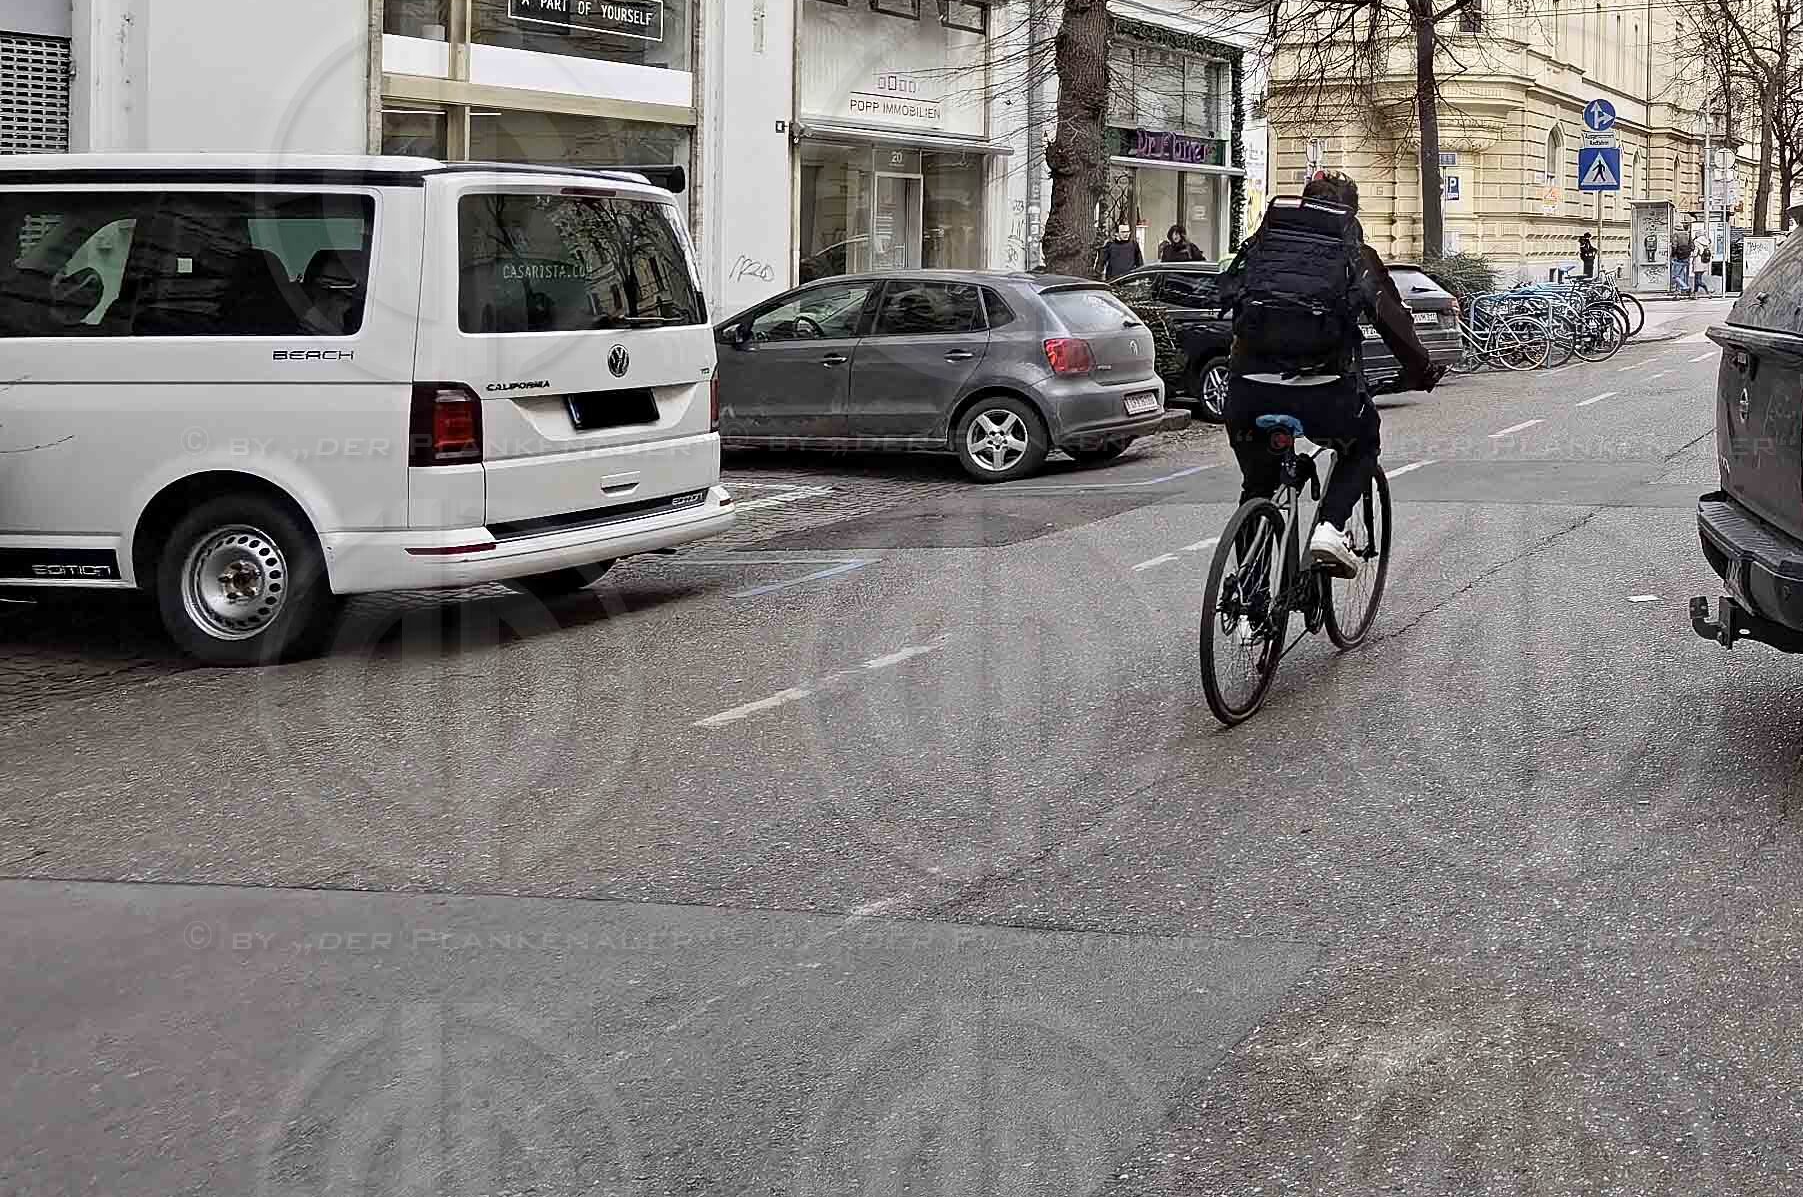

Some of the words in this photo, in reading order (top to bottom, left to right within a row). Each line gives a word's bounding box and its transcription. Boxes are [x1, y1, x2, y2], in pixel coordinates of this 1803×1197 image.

[578, 0, 592, 16] OF
[601, 4, 653, 26] YOURSELF
[850, 99, 880, 112] POPP
[883, 102, 941, 119] IMMOBILIEN
[891, 151, 903, 163] 20
[272, 349, 355, 361] BEACH
